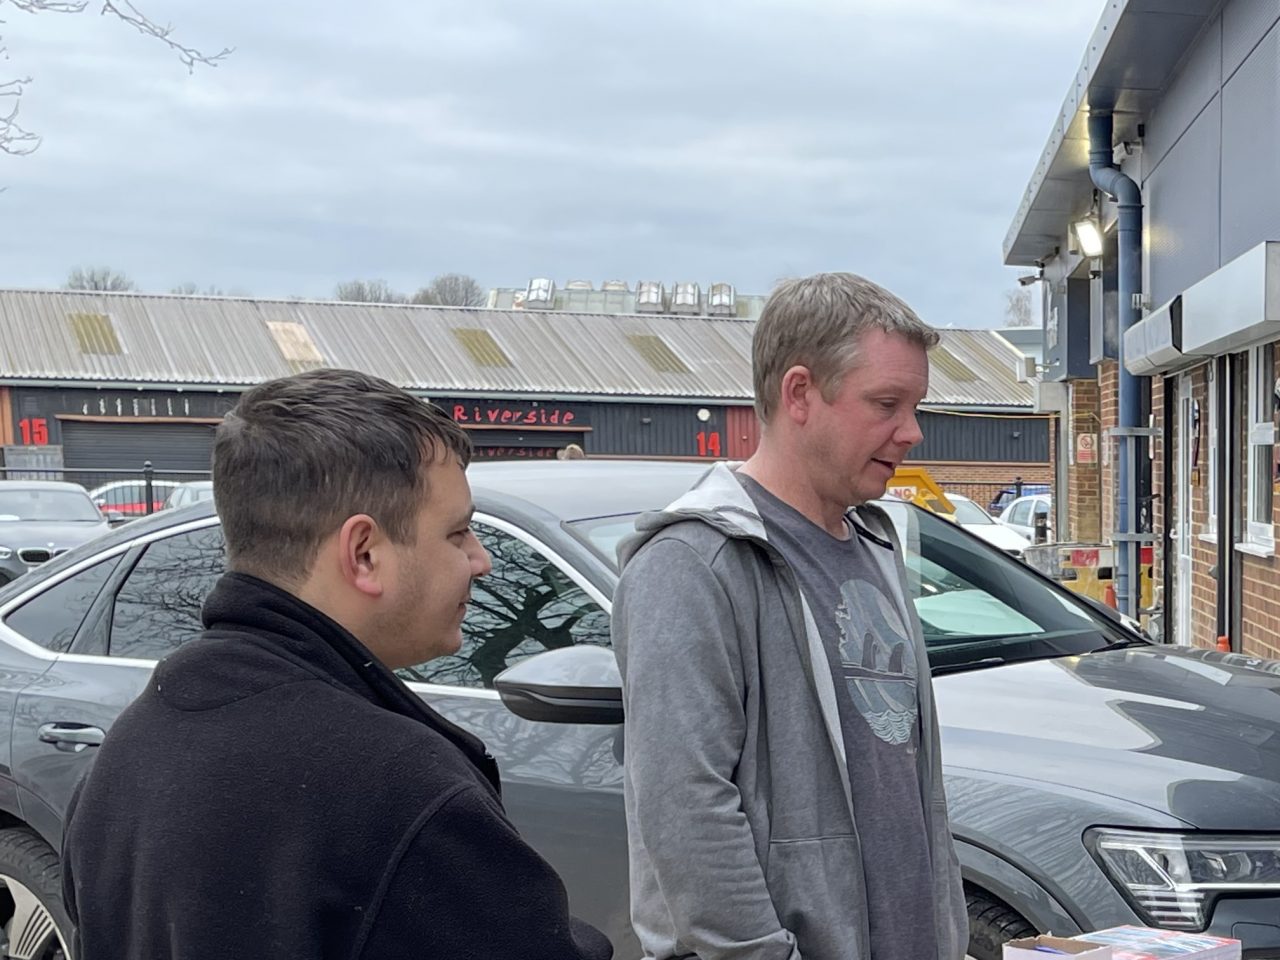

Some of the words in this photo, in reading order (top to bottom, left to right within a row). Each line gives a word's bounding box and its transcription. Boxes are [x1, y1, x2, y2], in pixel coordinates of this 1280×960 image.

[453, 404, 575, 425] Riverside
[19, 417, 49, 446] 15
[696, 431, 721, 458] 14
